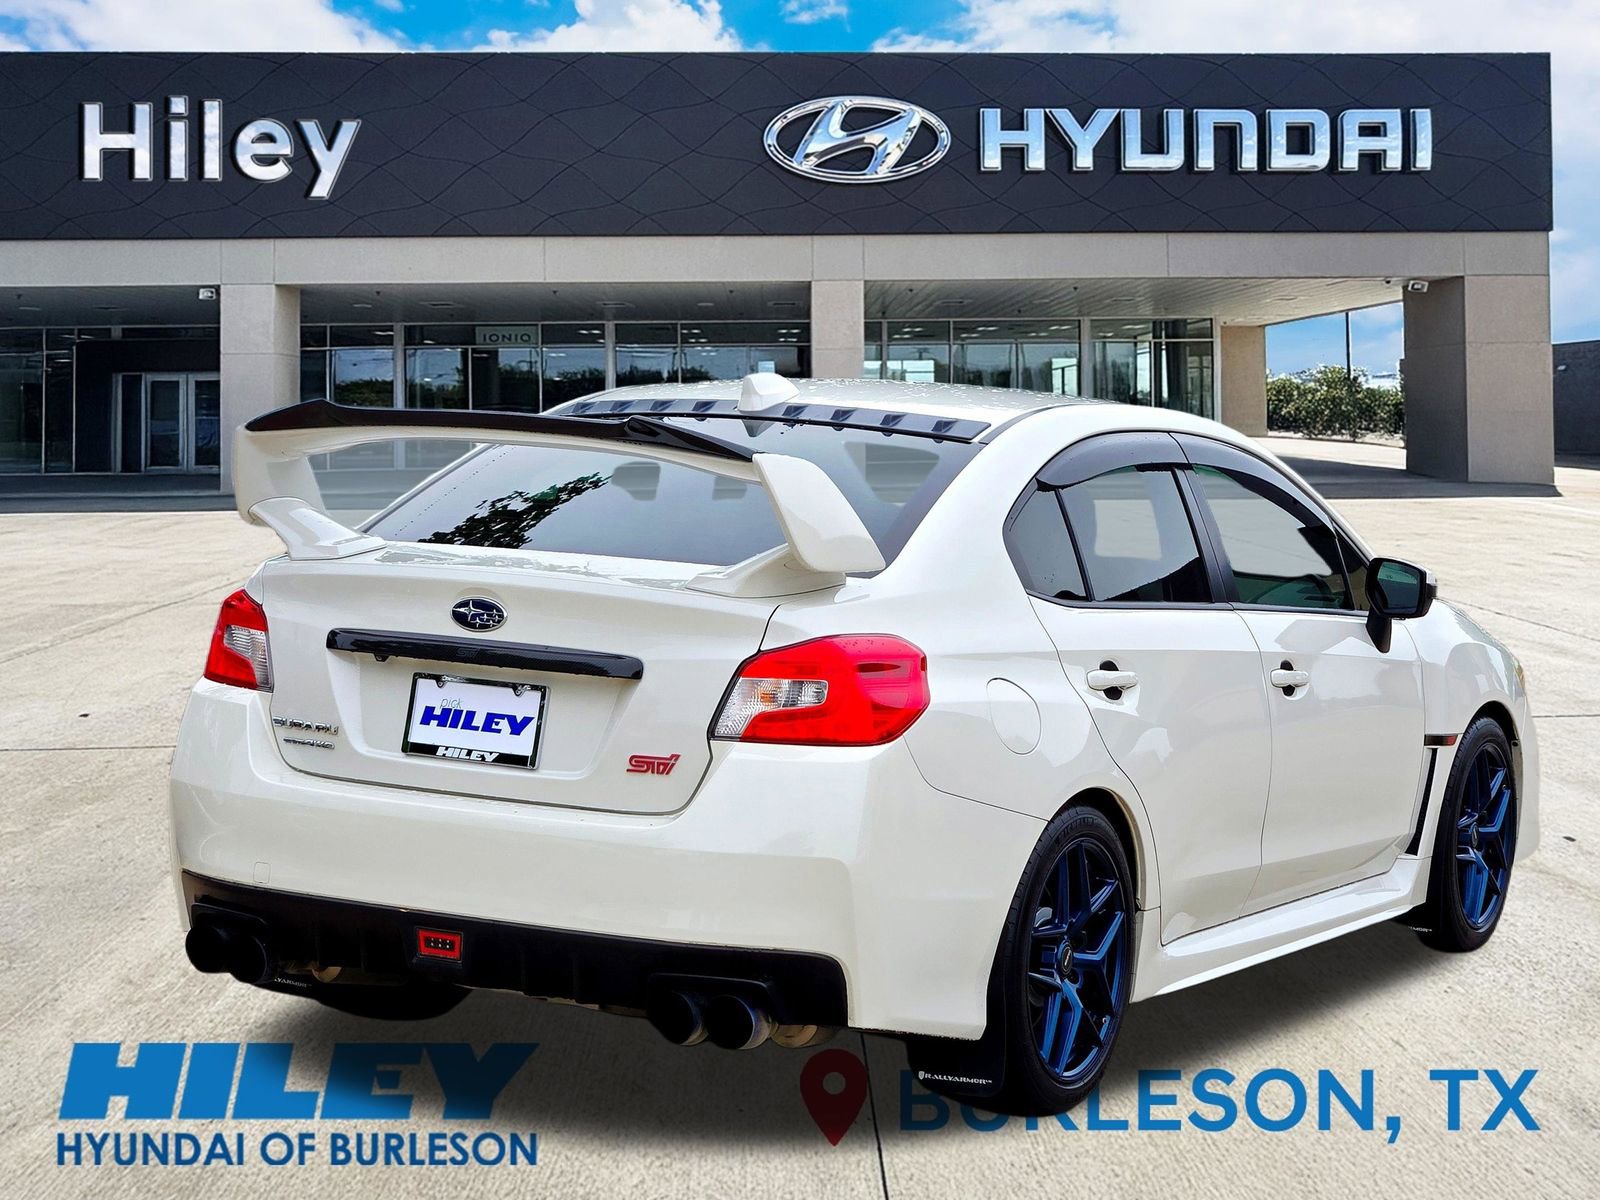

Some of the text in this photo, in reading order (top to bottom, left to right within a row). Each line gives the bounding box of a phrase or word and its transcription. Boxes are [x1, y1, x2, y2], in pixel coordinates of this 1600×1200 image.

[79, 95, 361, 199] Hiley
[980, 108, 1432, 172] HYUNDAI
[420, 706, 535, 736] HILEY
[435, 746, 499, 762] HILEY
